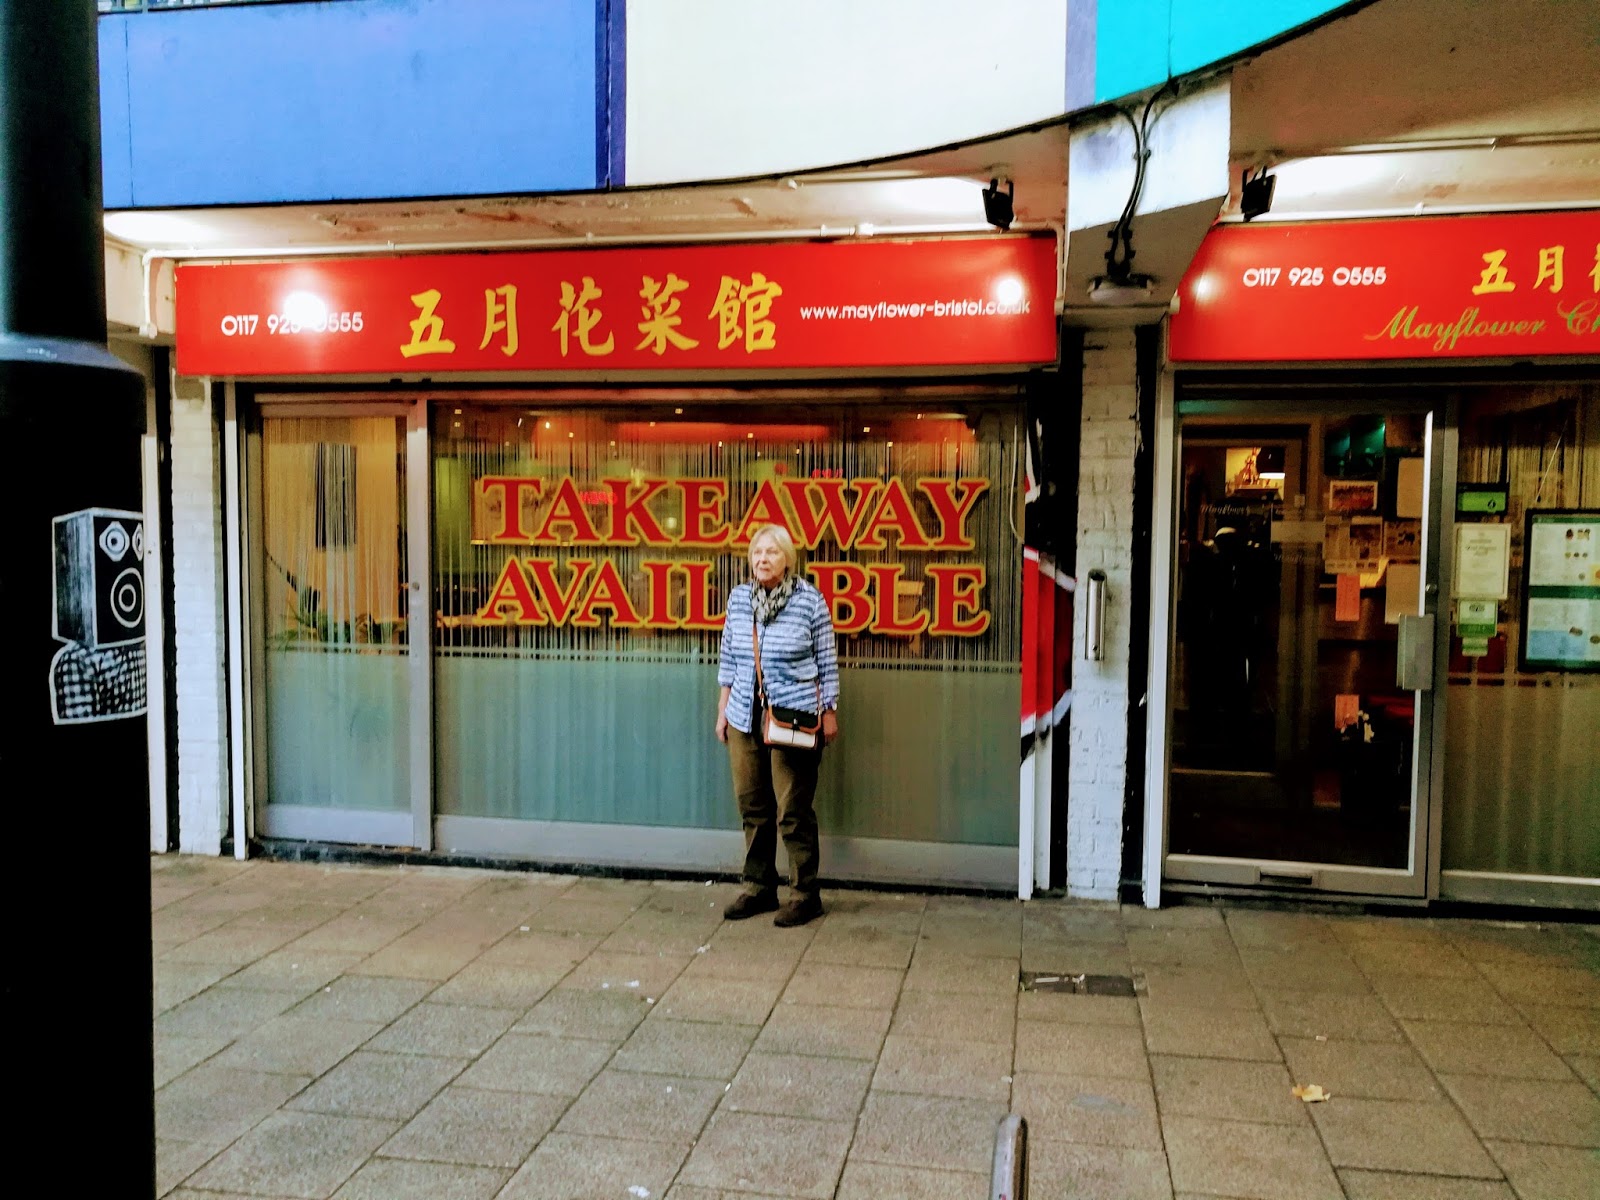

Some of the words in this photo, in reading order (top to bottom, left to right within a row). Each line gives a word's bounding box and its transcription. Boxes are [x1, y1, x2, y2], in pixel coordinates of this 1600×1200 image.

[1243, 267, 1281, 287] 0117
[1288, 266, 1324, 286] 925
[1332, 266, 1387, 286] 0555
[1472, 243, 1600, 296] 五月
[221, 314, 259, 336] 0117
[400, 271, 783, 358] 五月花菜館
[800, 299, 1030, 321] www.mayflower-bristol.co.uk
[1363, 305, 1547, 352] Mayflower
[1557, 298, 1600, 335] C
[481, 475, 991, 551] TAKEAWAY
[477, 556, 992, 638] AVAILBLE
